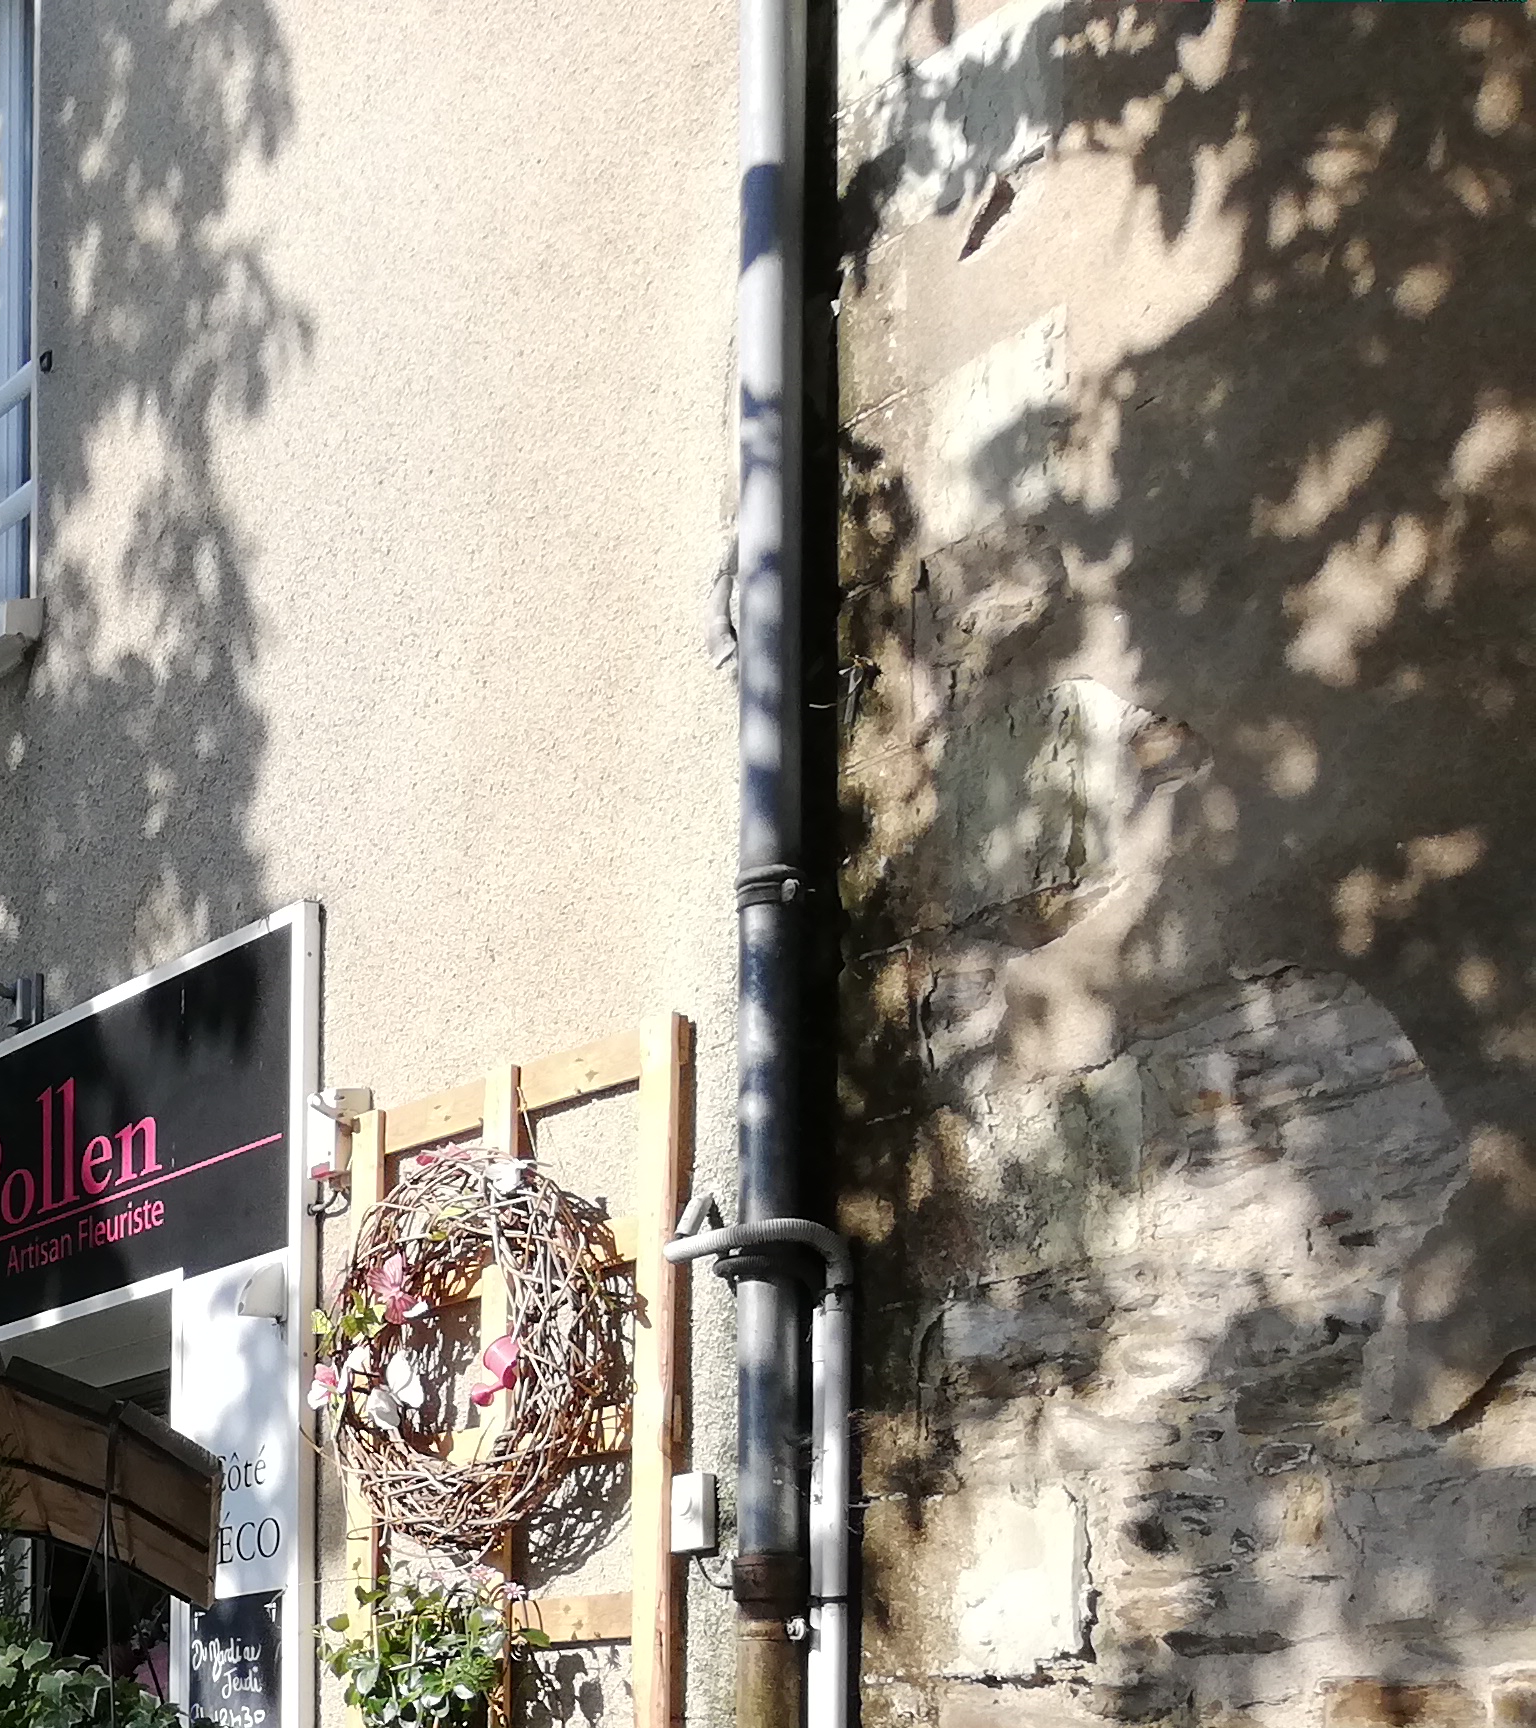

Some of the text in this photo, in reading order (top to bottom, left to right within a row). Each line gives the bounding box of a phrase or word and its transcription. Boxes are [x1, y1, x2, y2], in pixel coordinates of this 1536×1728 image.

[5, 1198, 166, 1278] Artisan Fleuriste
[216, 1511, 281, 1565] ÉCO
